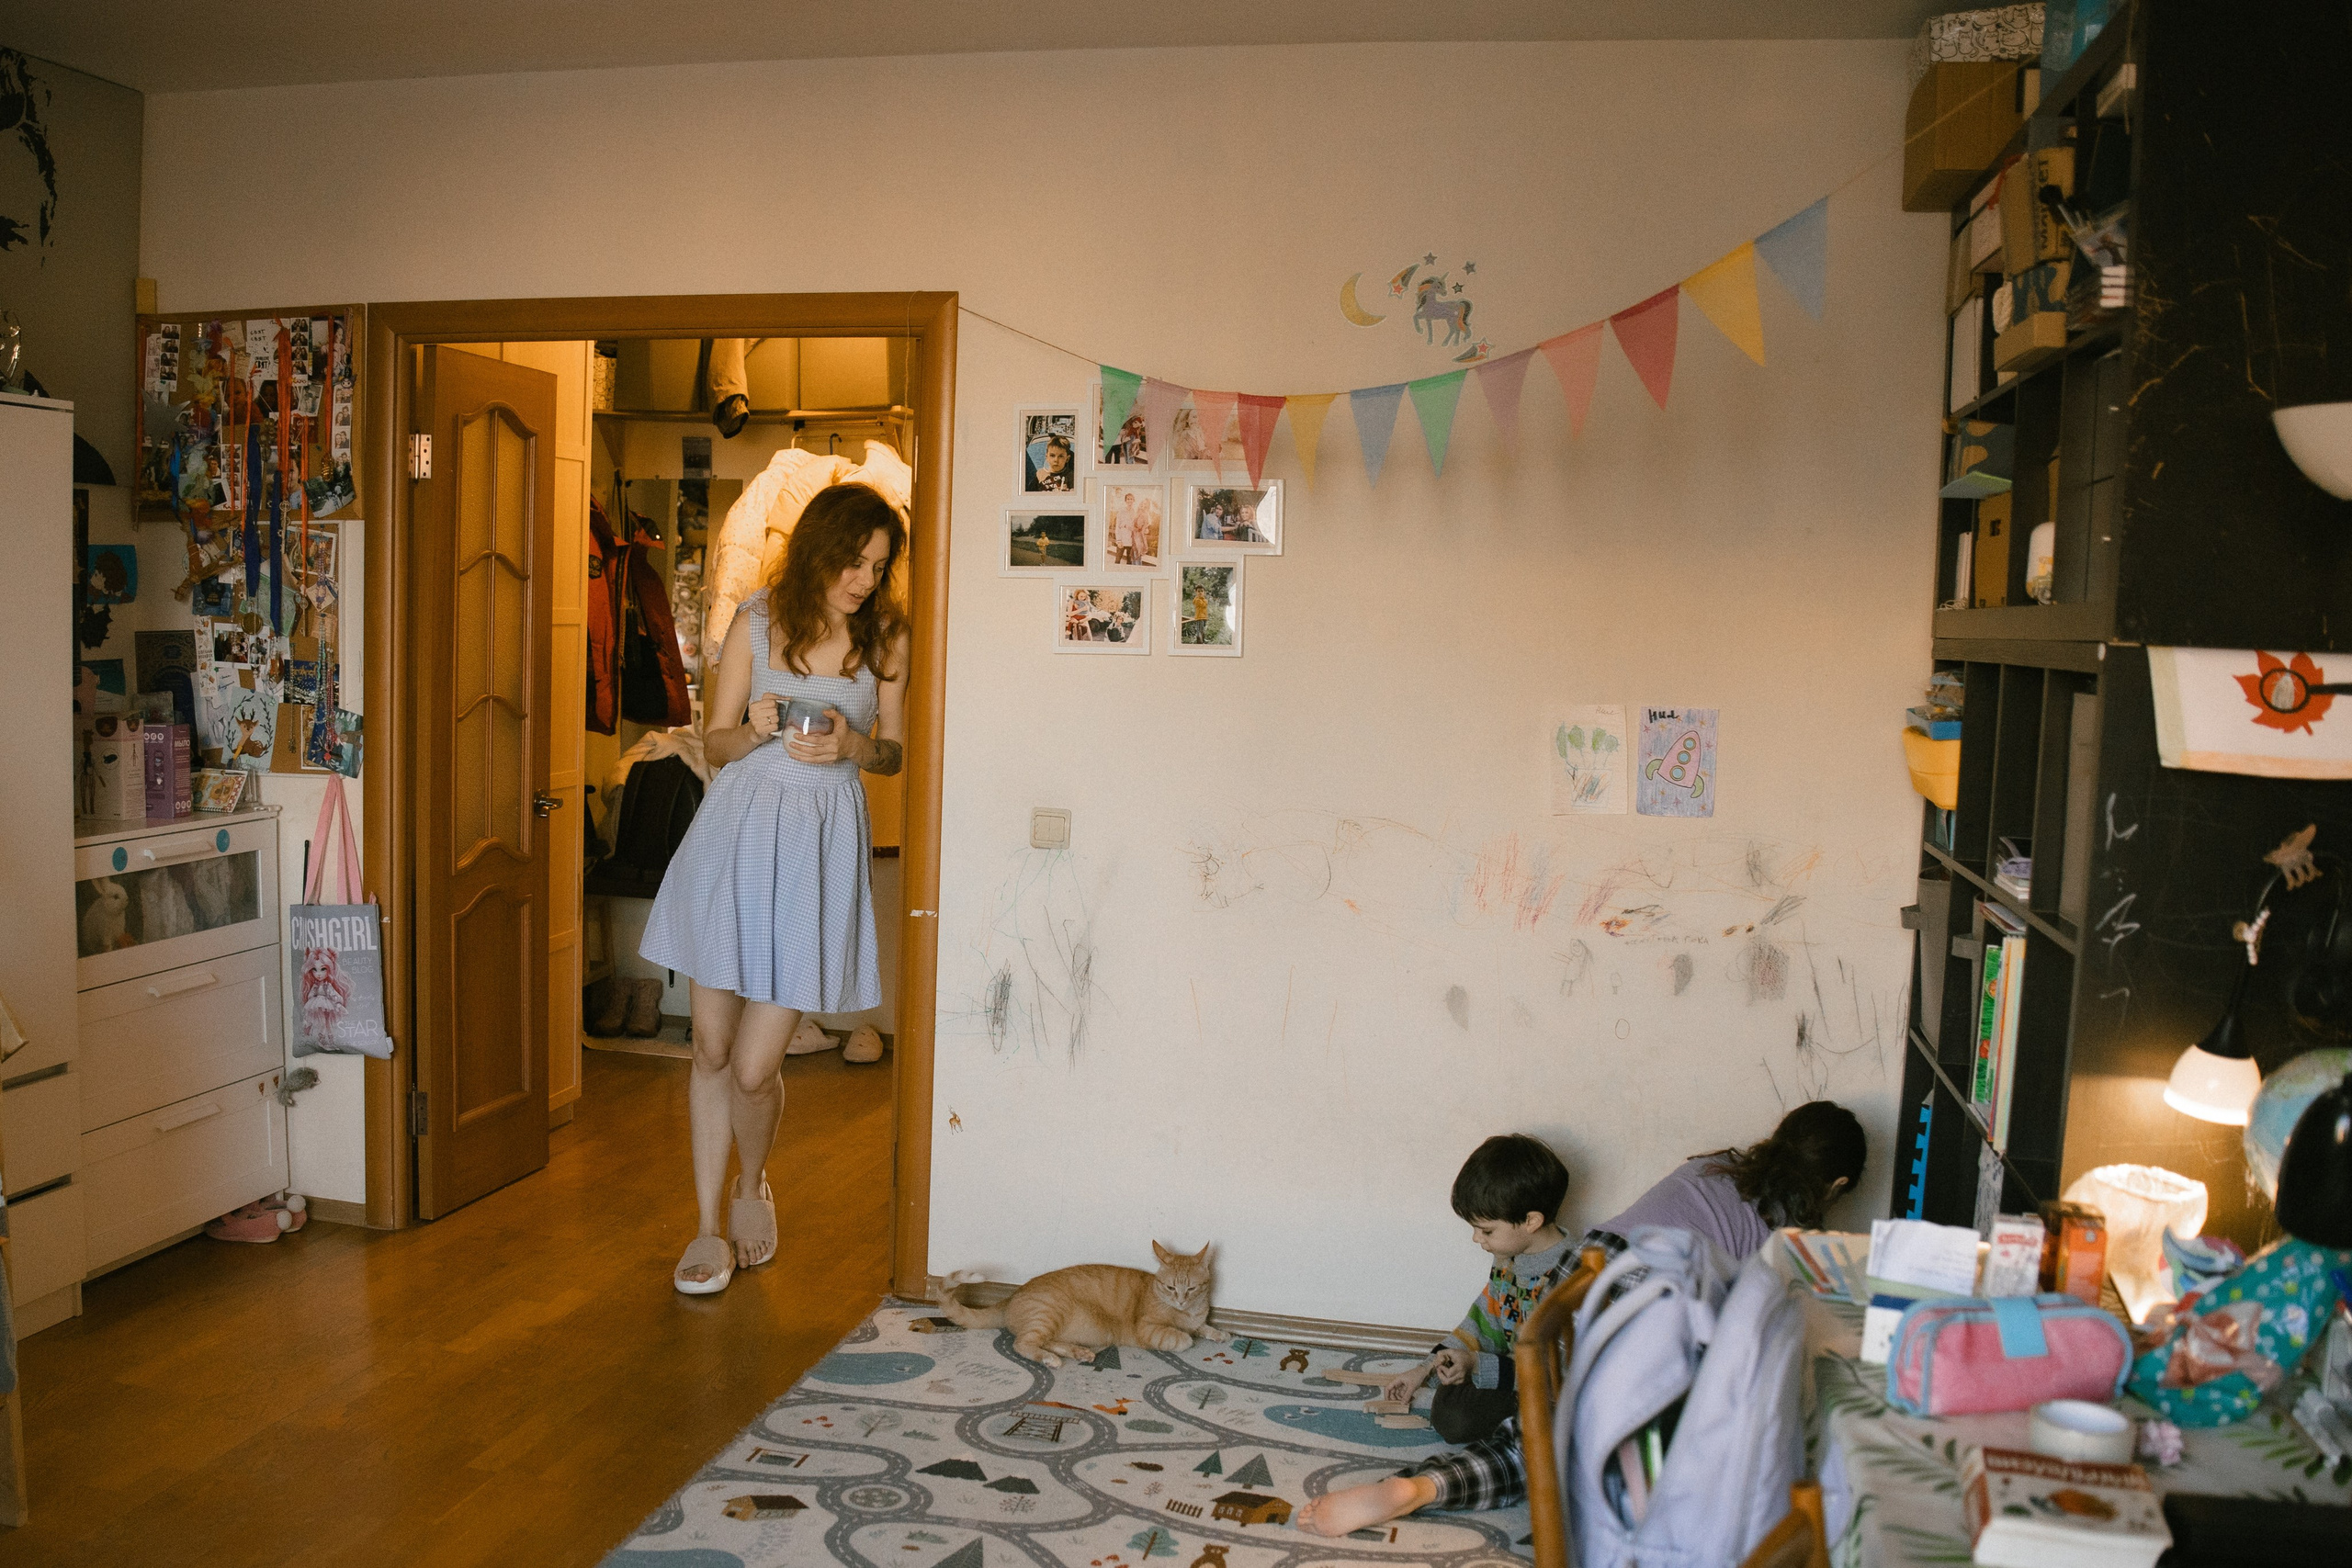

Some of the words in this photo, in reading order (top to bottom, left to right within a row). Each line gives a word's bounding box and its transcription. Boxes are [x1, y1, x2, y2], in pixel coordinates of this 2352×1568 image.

[174, 739, 190, 748] МЫЛО
[342, 956, 372, 966] BEAUTY
[351, 965, 374, 975] BLOG
[336, 1019, 379, 1039] STAR
